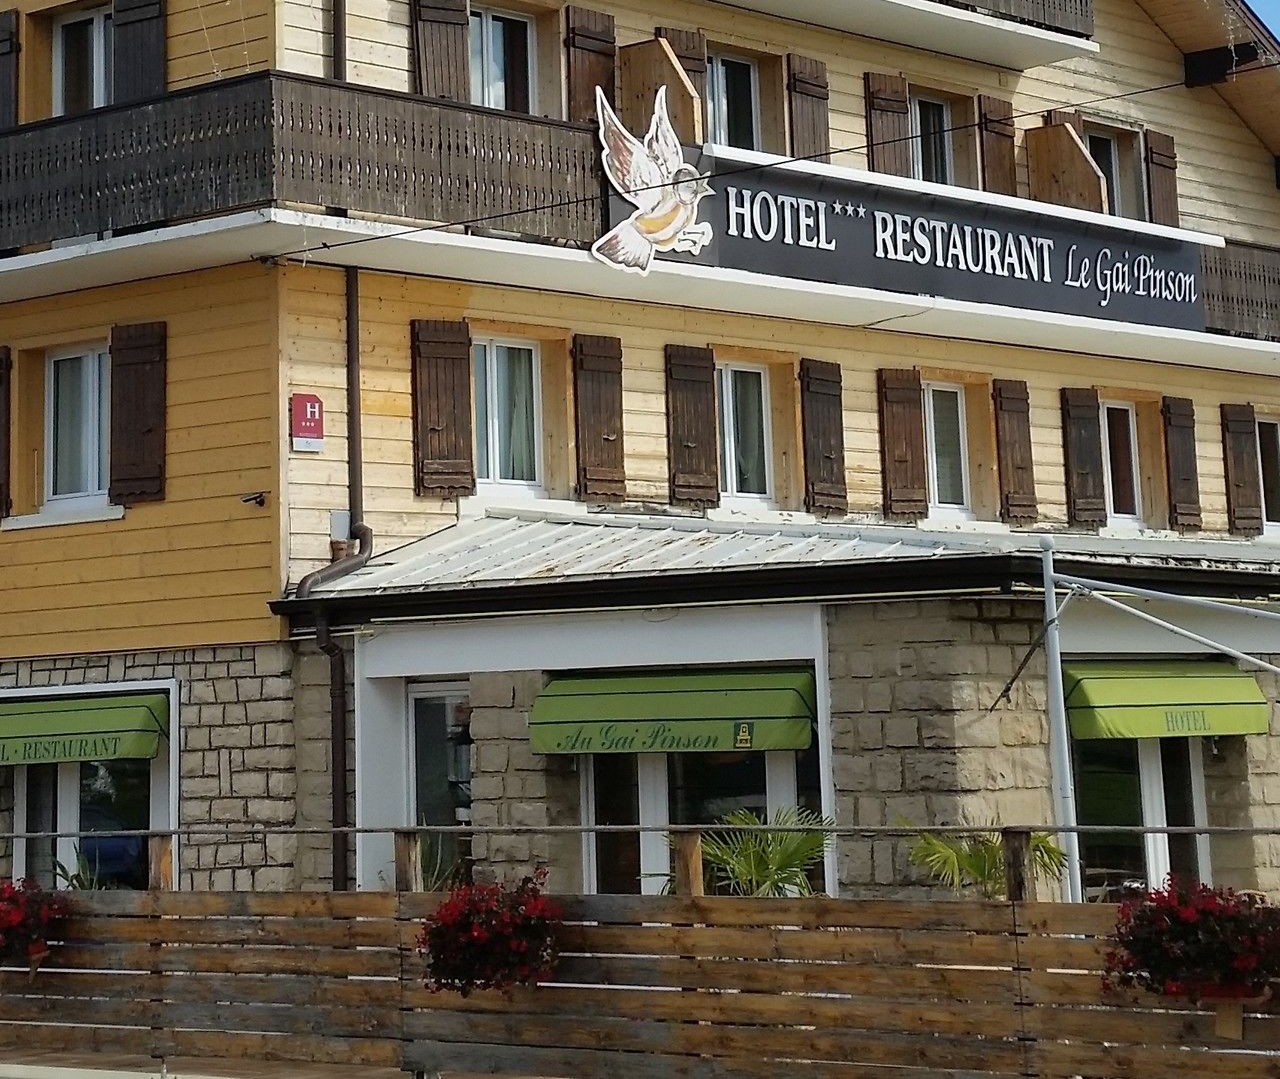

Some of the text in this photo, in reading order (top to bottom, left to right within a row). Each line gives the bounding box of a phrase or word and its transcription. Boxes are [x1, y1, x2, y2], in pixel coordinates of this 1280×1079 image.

[727, 186, 1198, 307] HOTEL RESTAURANT Le Gai Pinson
[306, 402, 320, 419] H
[1165, 711, 1211, 731] HOTEL
[22, 737, 121, 761] RESTAURANT
[556, 724, 720, 750] Au Gai Pinson
